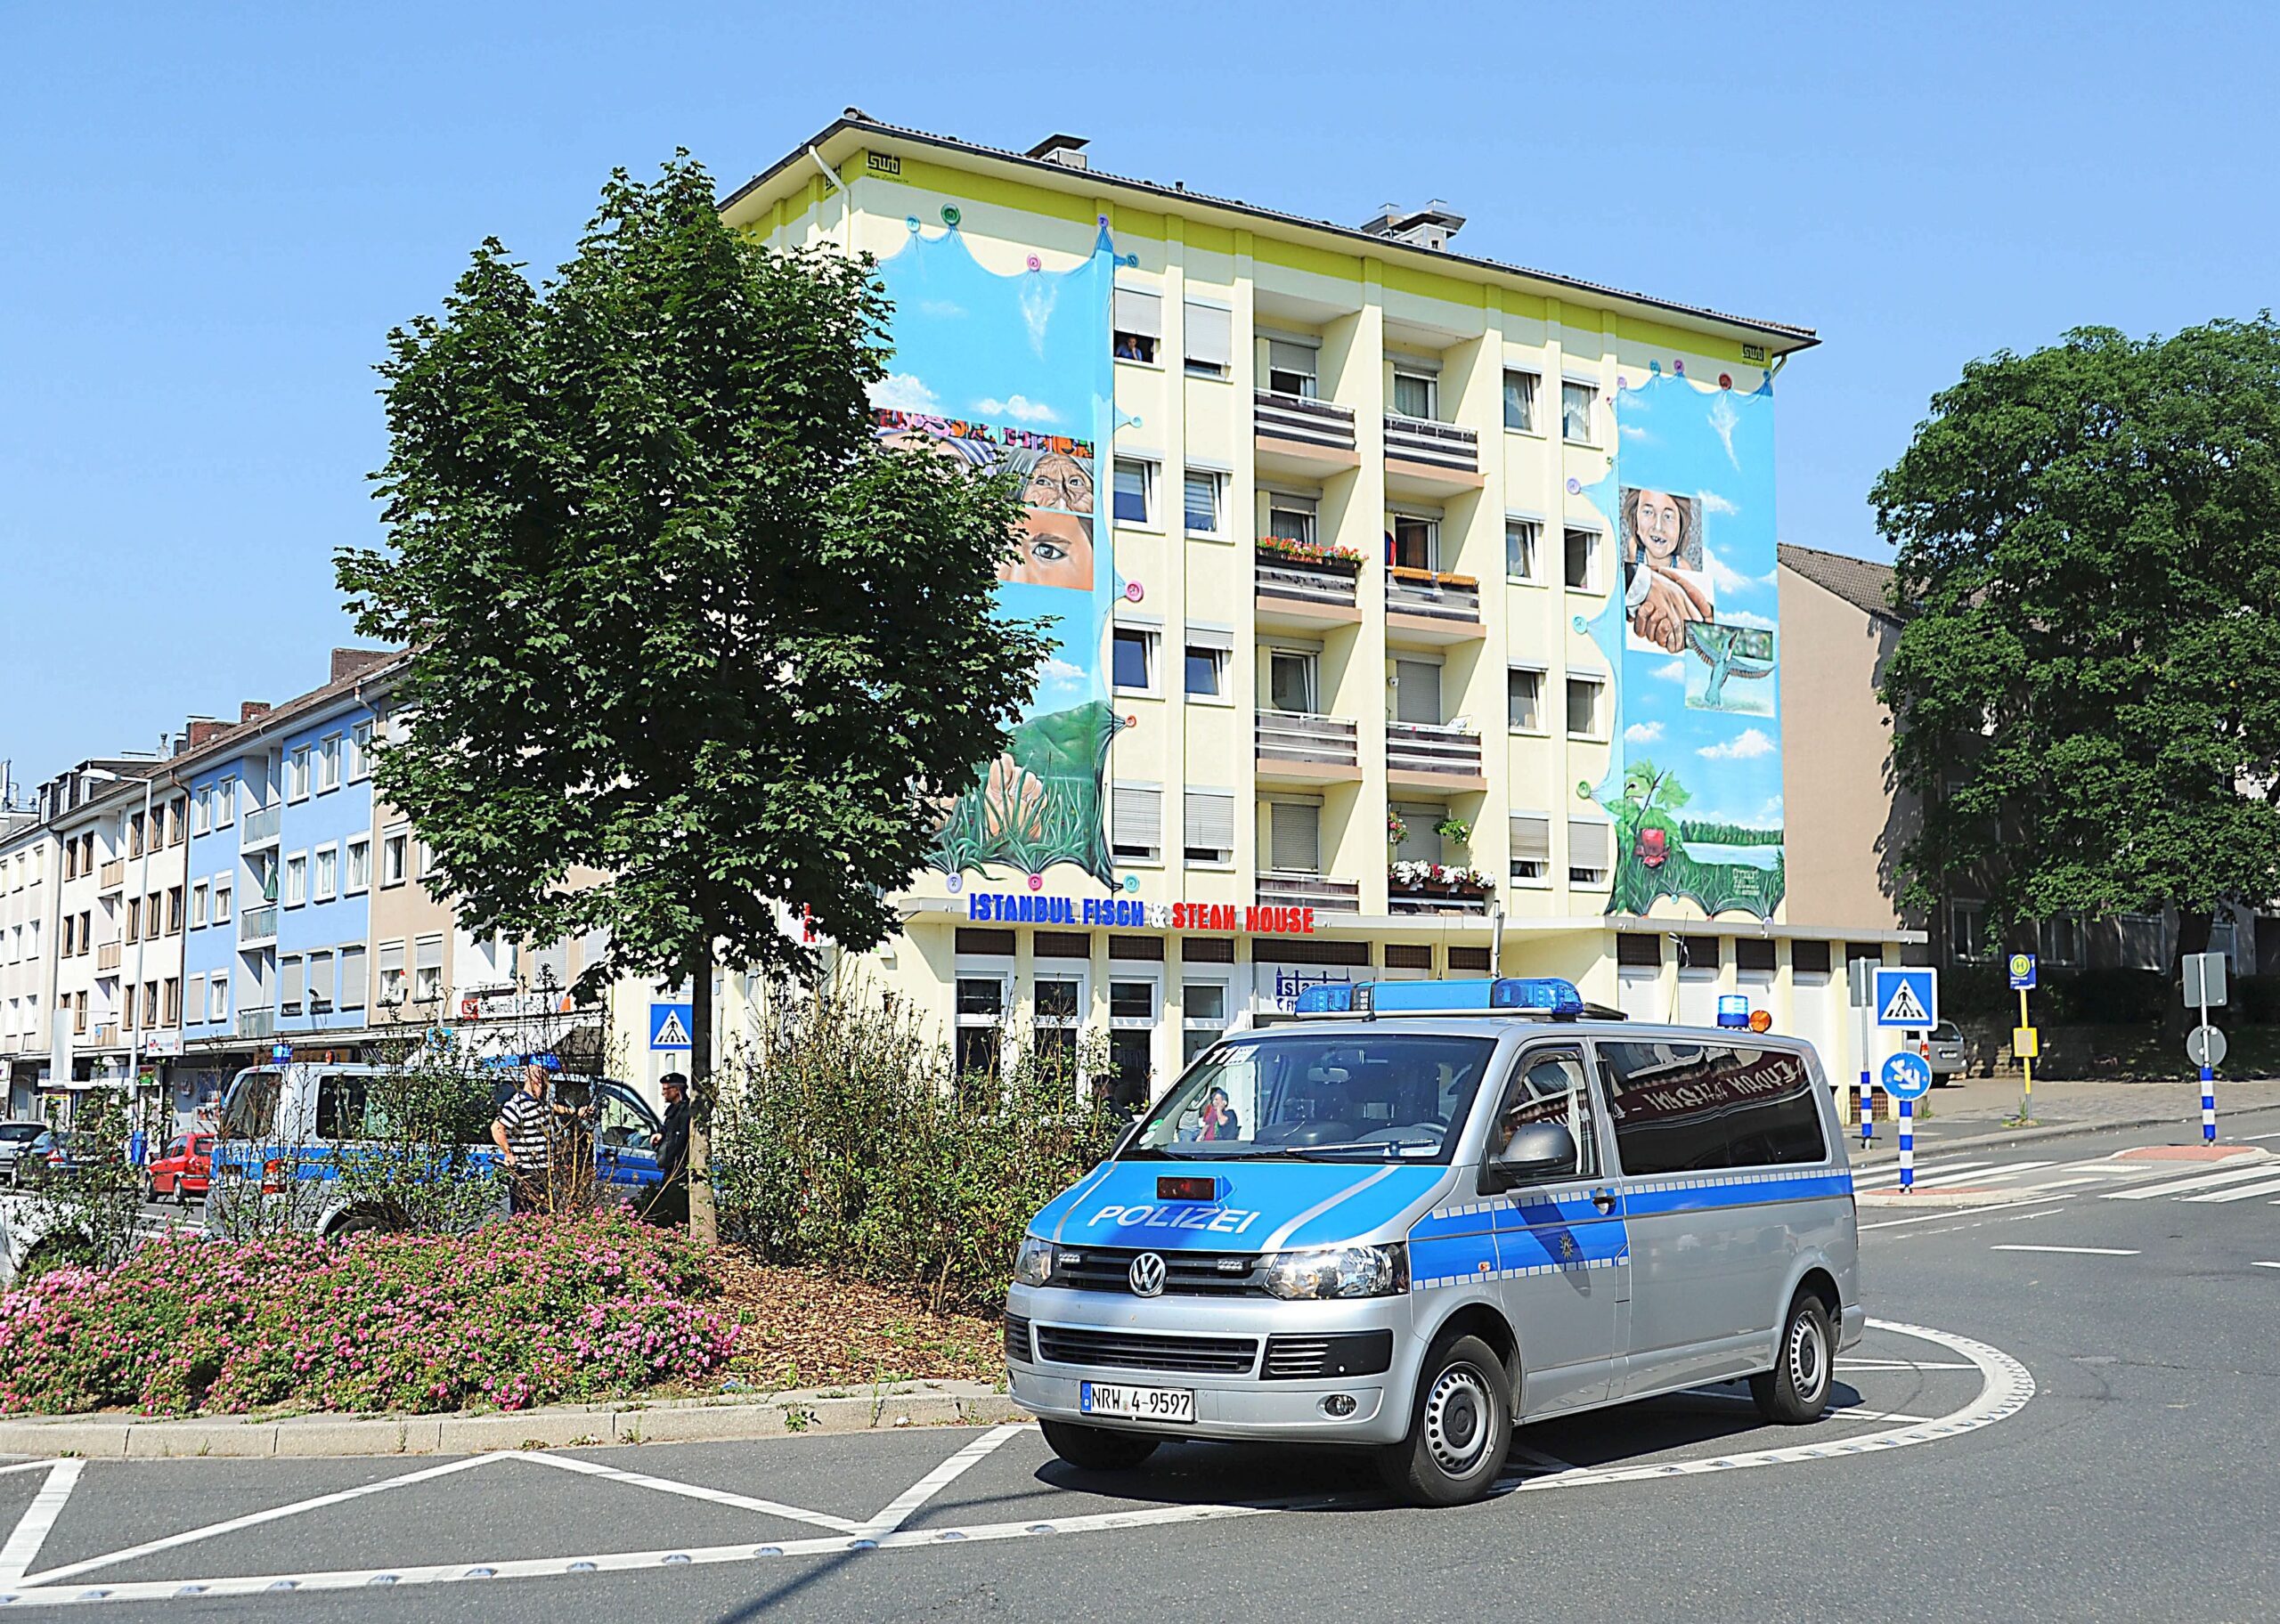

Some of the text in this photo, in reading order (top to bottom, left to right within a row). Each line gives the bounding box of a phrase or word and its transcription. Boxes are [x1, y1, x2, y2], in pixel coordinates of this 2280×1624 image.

[970, 893, 1314, 933] ISTANBUL FISCH & STEAK HOUSE
[1205, 1045, 1240, 1066] 11
[1087, 1205, 1261, 1234] POLIZEI
[1092, 1387, 1190, 1416] NRW 4-9597
